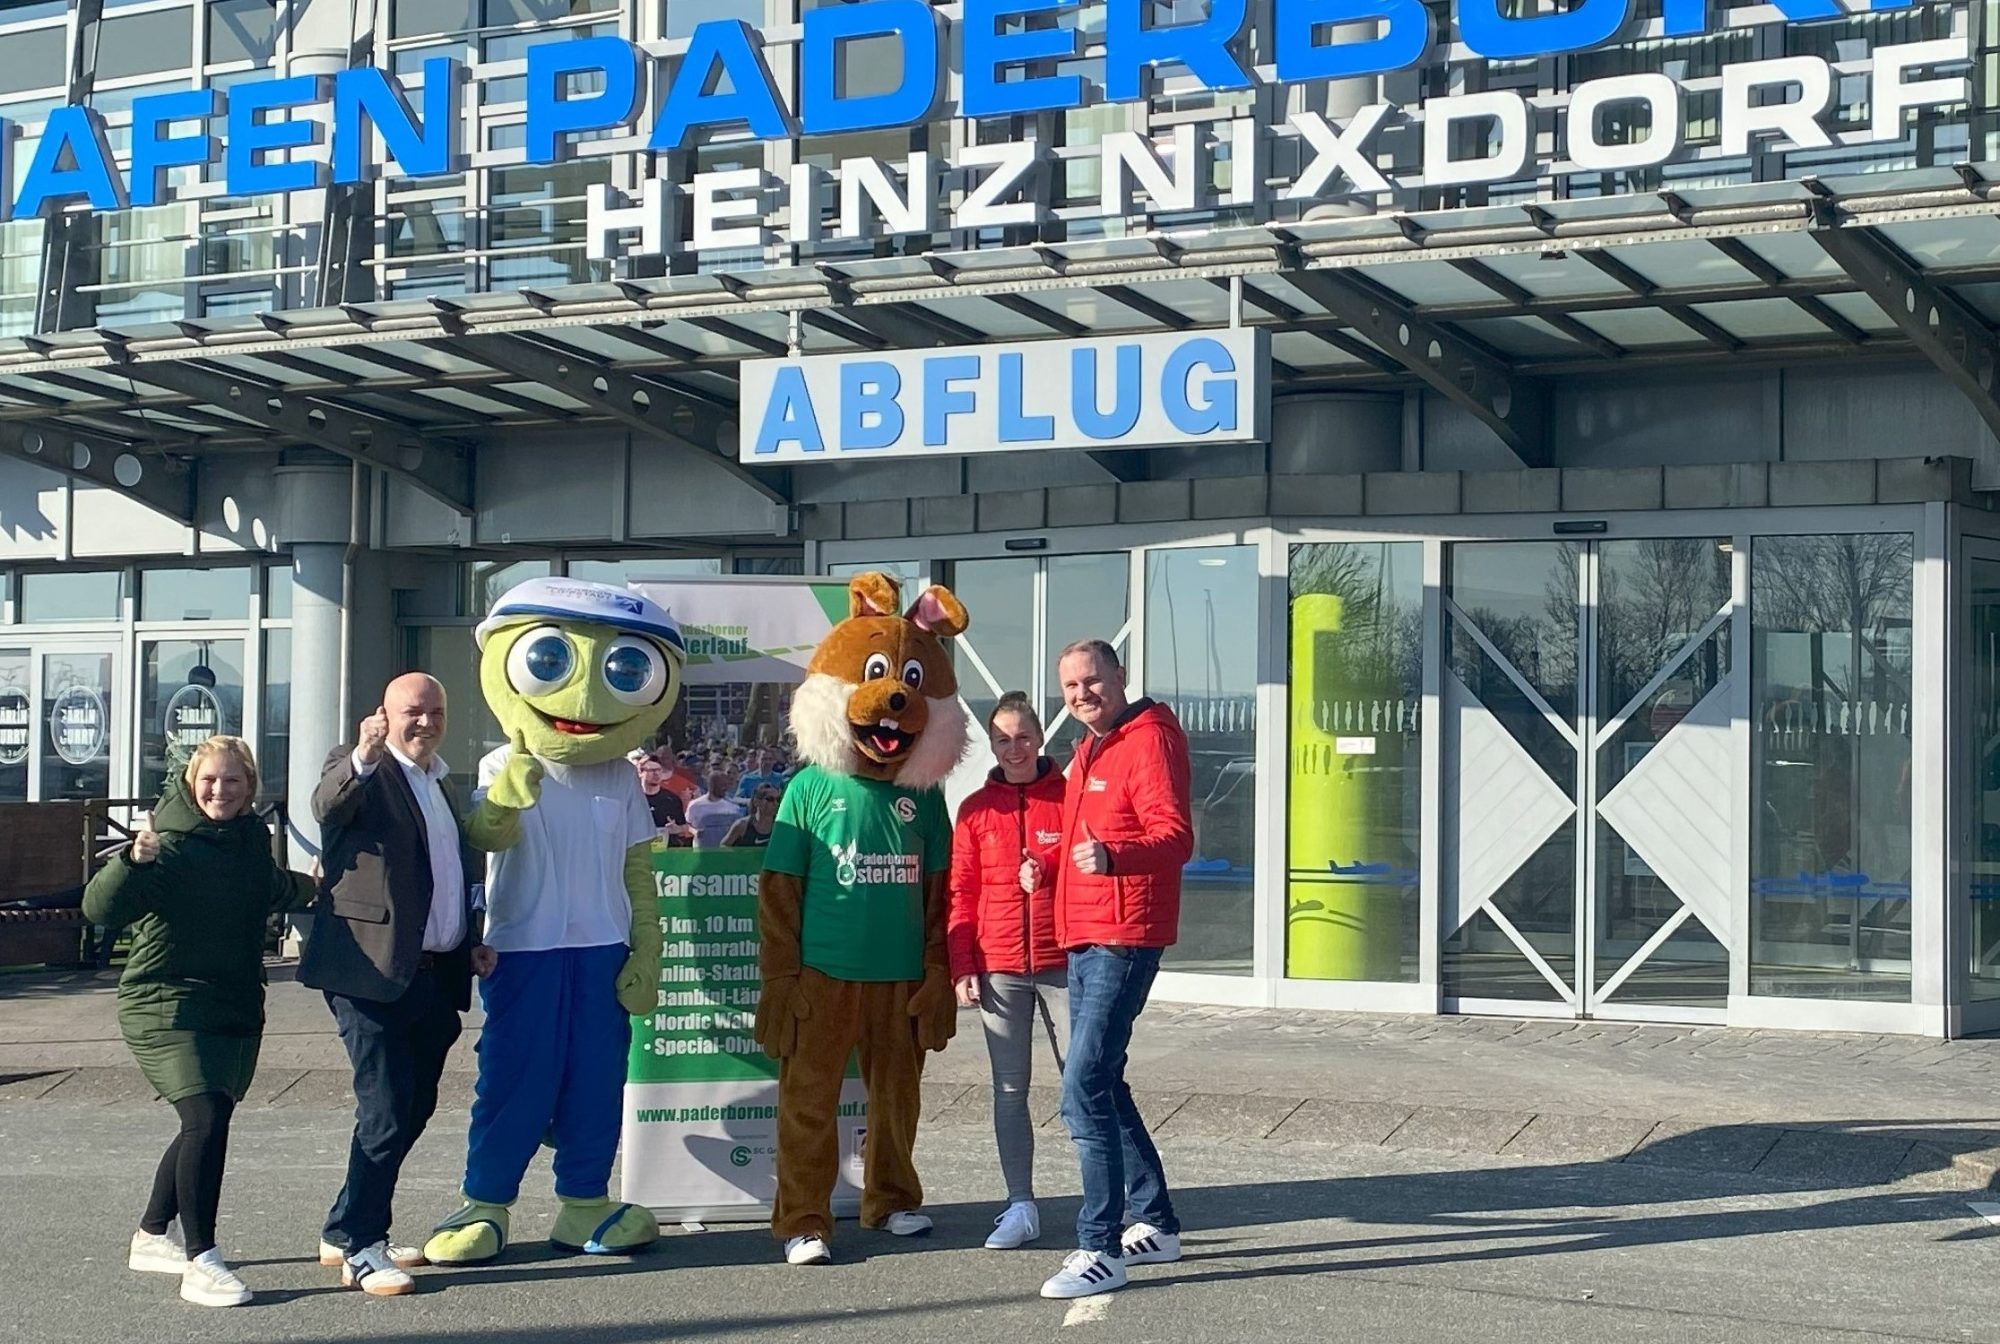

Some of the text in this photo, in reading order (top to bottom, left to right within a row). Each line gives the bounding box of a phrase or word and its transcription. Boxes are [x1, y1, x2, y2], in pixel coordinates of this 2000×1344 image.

[0, 0, 1913, 218] AFEN PADERB
[586, 37, 1969, 260] HEINZ NIXDORF
[755, 338, 1238, 453] ABFLUG
[680, 624, 748, 635] aderborner
[704, 915, 723, 933] 10
[728, 915, 753, 933] km
[662, 940, 761, 958] albmarath
[660, 964, 760, 982] nline-Skati
[657, 987, 761, 1007] Bambini-Läu
[655, 1012, 756, 1031] Nordic Walk
[655, 1037, 763, 1056] Special-Olym
